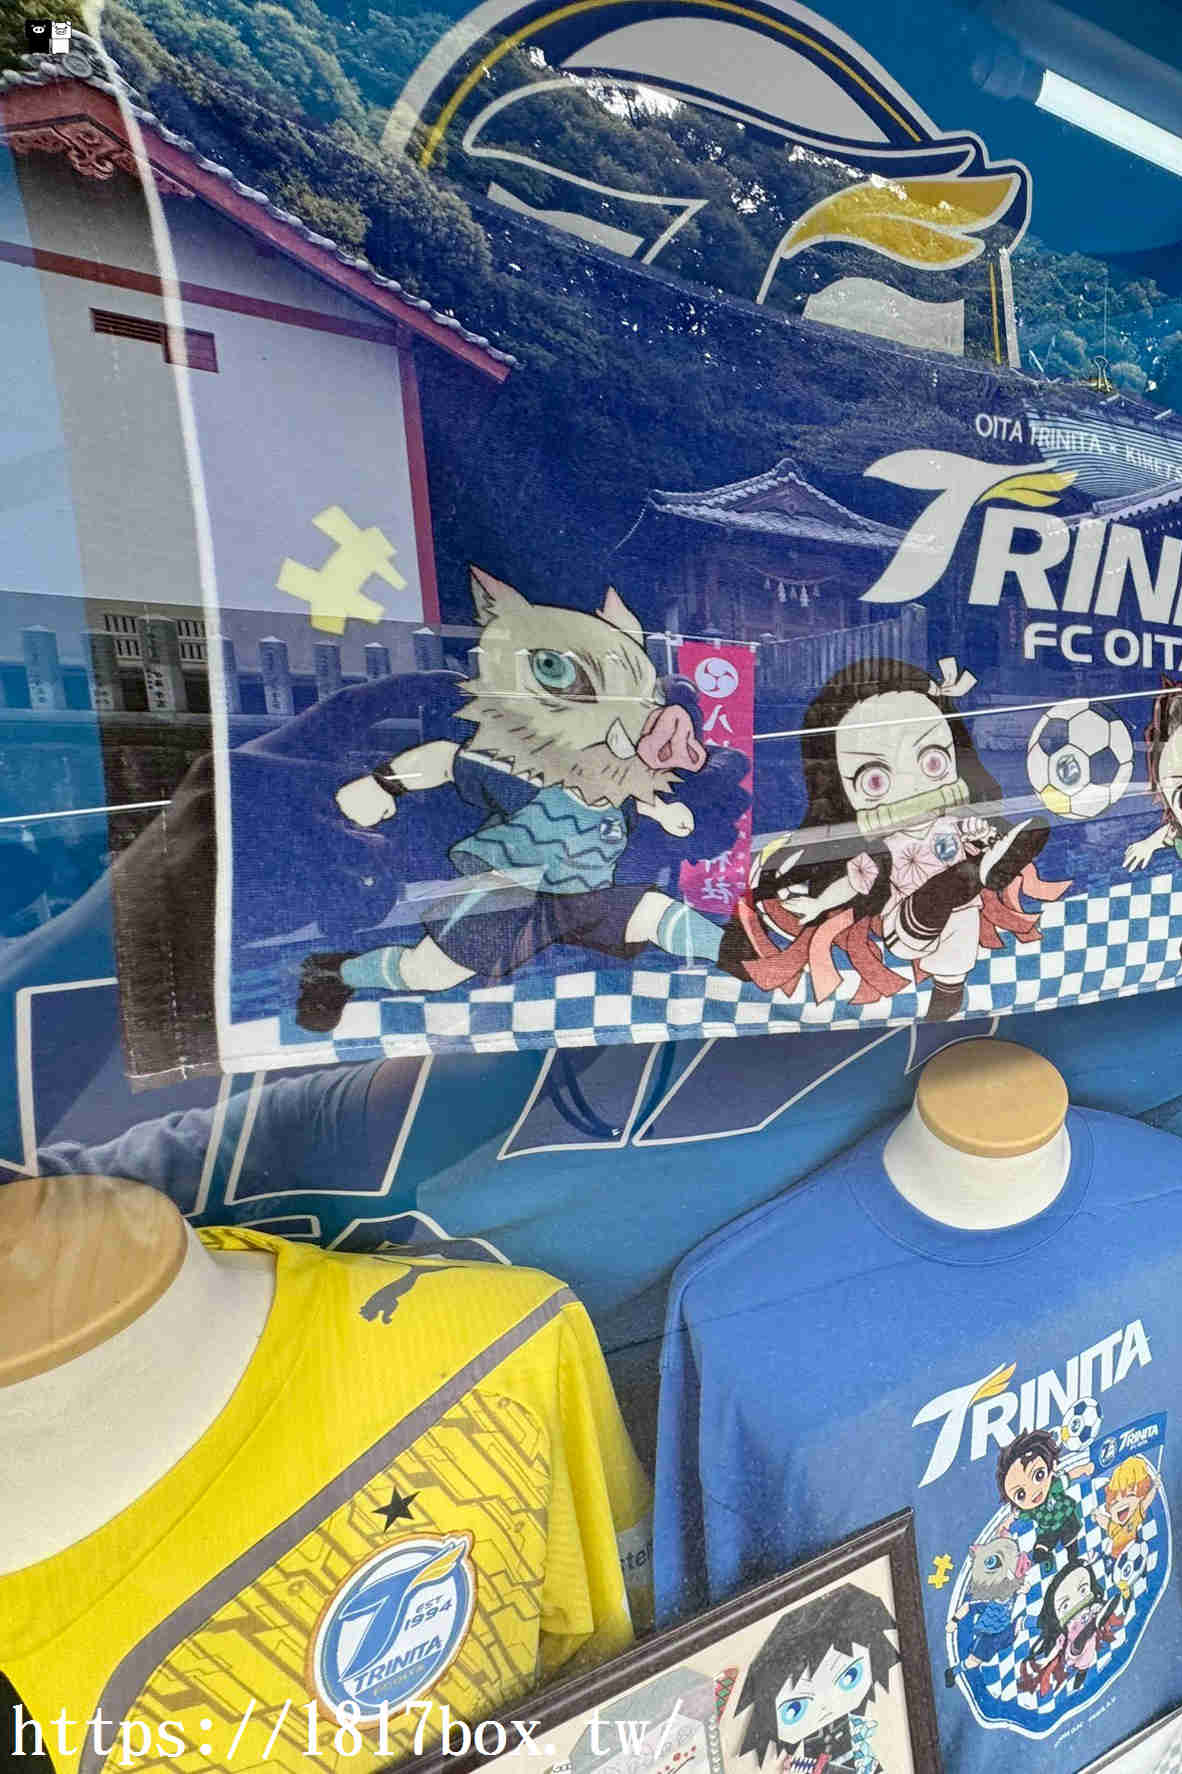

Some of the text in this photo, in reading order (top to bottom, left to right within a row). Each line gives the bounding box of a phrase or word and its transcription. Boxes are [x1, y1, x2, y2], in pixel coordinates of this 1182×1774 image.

[974, 414, 1023, 444] OITA
[1029, 421, 1102, 455] TRINITA
[1023, 622, 1093, 664] FC
[911, 1319, 1153, 1489] TRINITA
[404, 1597, 454, 1633] 1994
[353, 1634, 443, 1692] TRINITA
